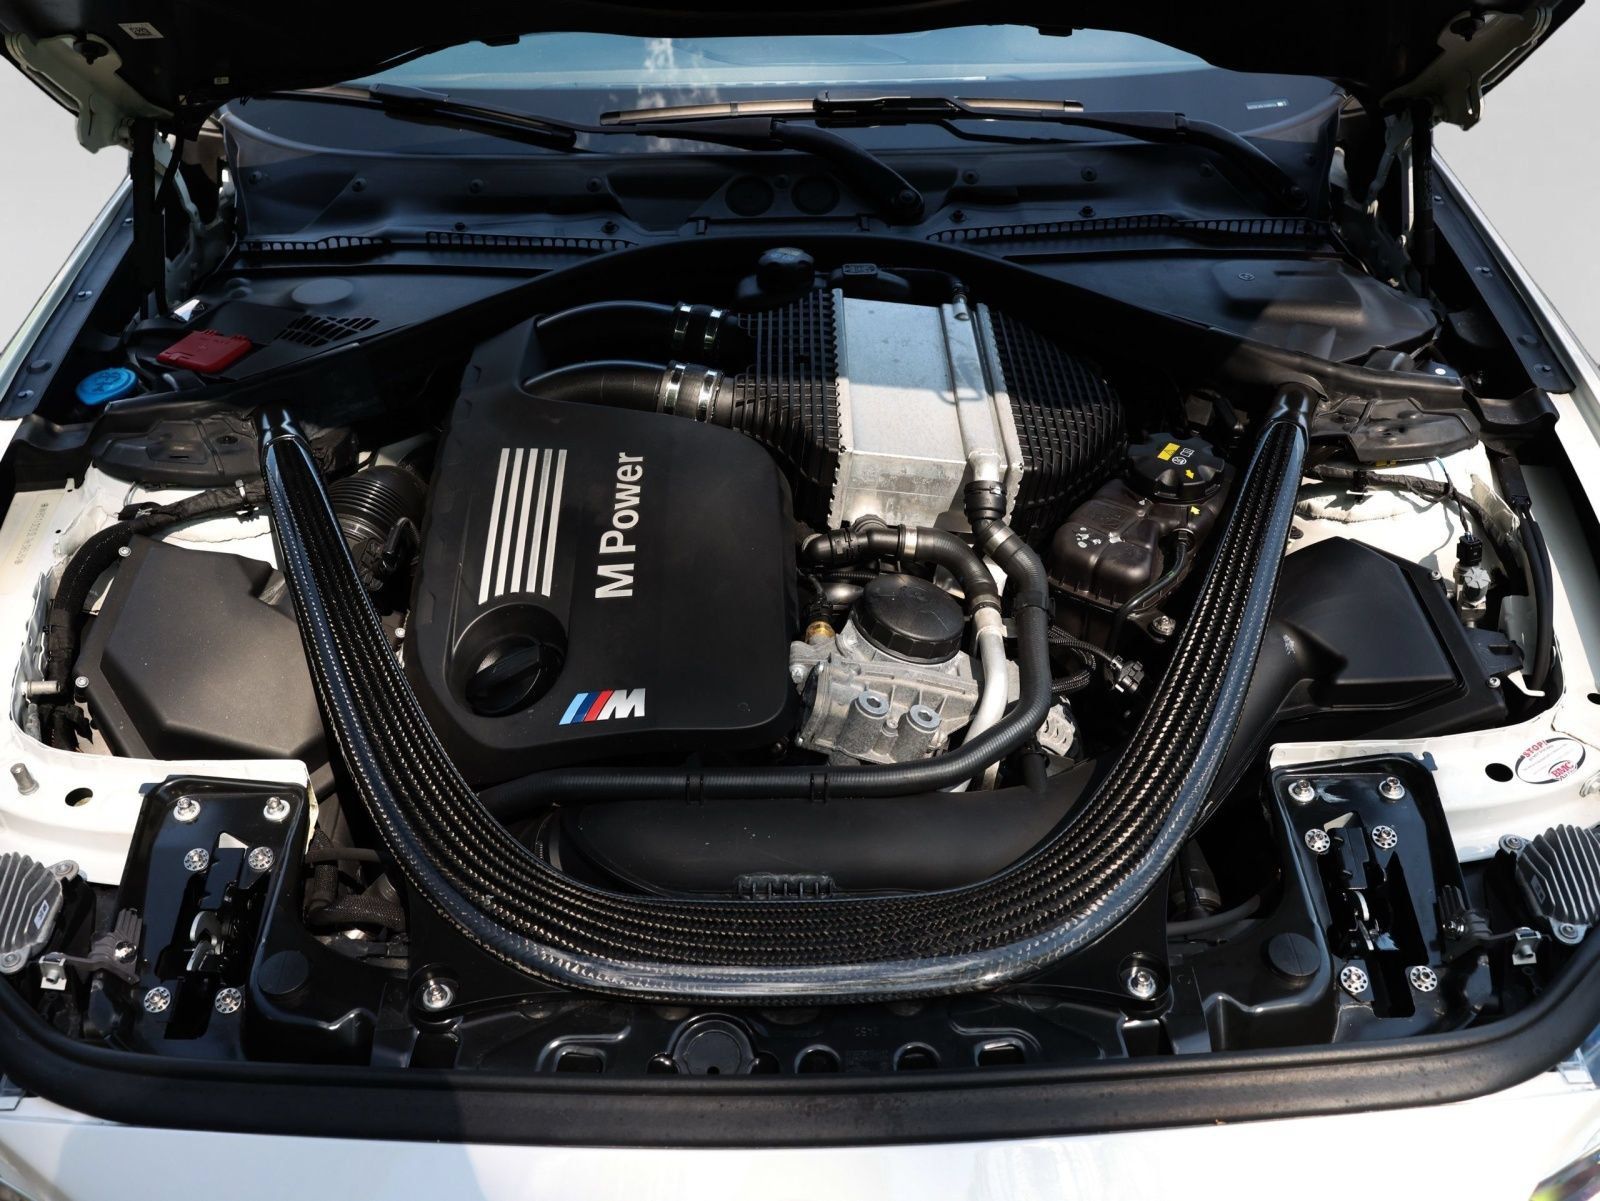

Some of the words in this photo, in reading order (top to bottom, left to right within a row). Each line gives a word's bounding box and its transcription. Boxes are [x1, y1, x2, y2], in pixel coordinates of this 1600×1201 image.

[599, 451, 644, 554] Power
[594, 563, 635, 599] M
[1522, 739, 1548, 758] STOP!
[1551, 761, 1574, 778] BMC
